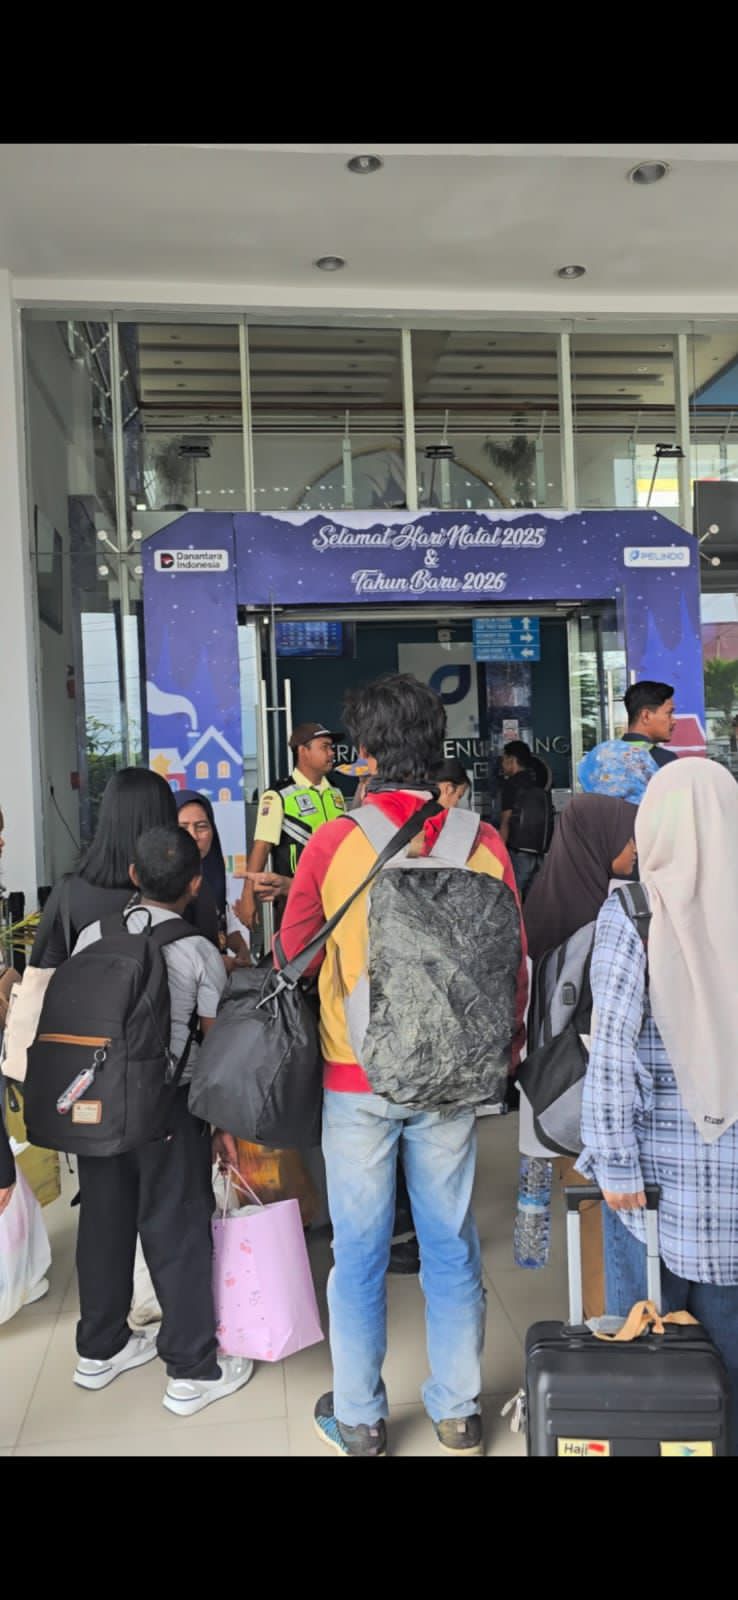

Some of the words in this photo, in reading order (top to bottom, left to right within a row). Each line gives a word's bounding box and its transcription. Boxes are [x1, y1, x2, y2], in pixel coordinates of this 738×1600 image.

[312, 525, 393, 548] Selamat
[392, 525, 446, 549] Hari
[446, 525, 500, 548] Natal
[501, 527, 546, 548] 2025
[176, 552, 223, 560] Danantara
[423, 549, 440, 568] &
[176, 561, 221, 569] Indonesia
[350, 568, 409, 594] Tahun
[408, 568, 460, 593] Baru
[461, 571, 508, 592] 2026
[564, 1443, 587, 1456] Haji
